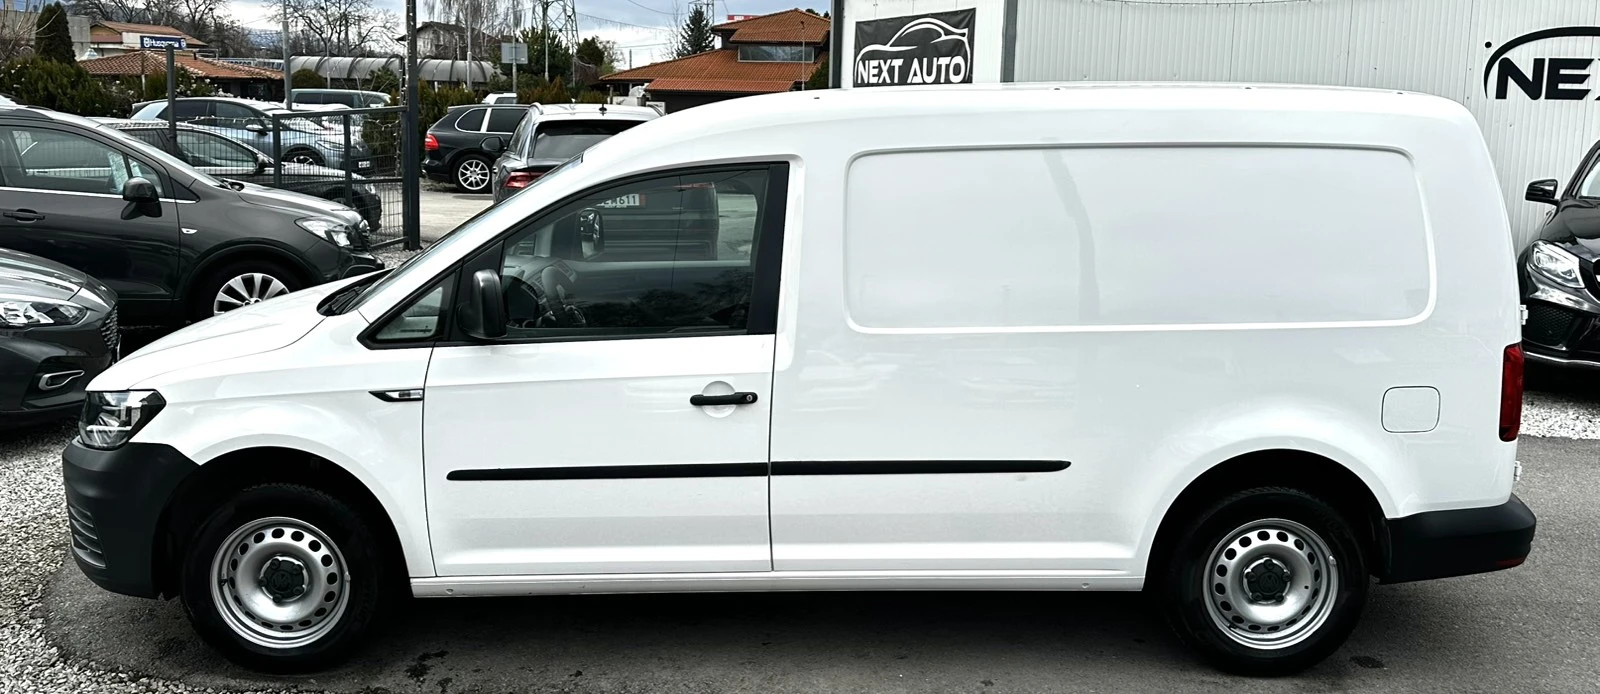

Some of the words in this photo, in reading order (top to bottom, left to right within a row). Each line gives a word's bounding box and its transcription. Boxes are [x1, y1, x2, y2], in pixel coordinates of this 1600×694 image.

[857, 58, 904, 84] NEXT
[906, 56, 966, 84] AUTO
[1495, 57, 1600, 101] NE
